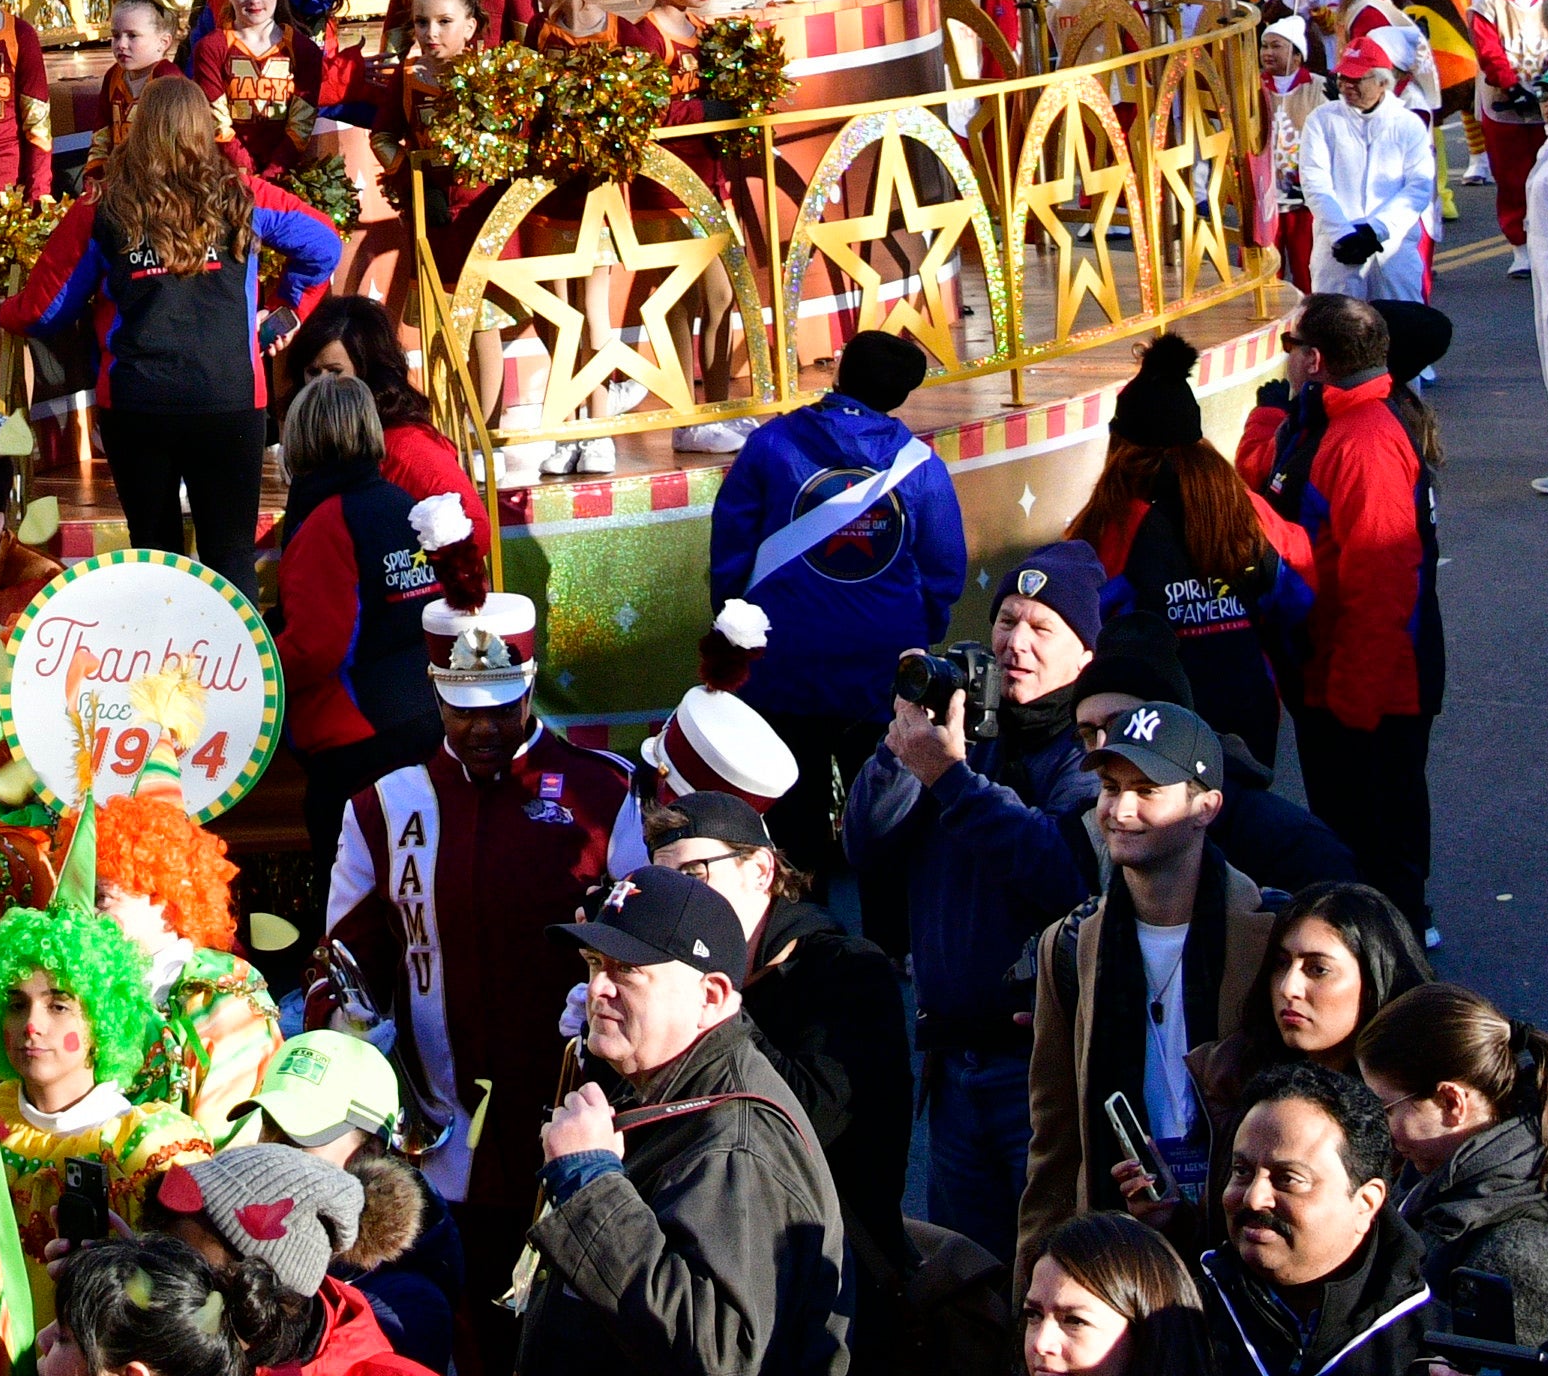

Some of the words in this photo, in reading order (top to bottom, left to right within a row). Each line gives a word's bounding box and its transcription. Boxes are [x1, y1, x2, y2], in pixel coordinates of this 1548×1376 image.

[385, 572, 400, 586] OF
[1168, 605, 1184, 620] OF
[1123, 707, 1161, 741] NY
[93, 725, 229, 781] 194
[398, 810, 432, 996] AAMU
[665, 1098, 711, 1113] Canon
